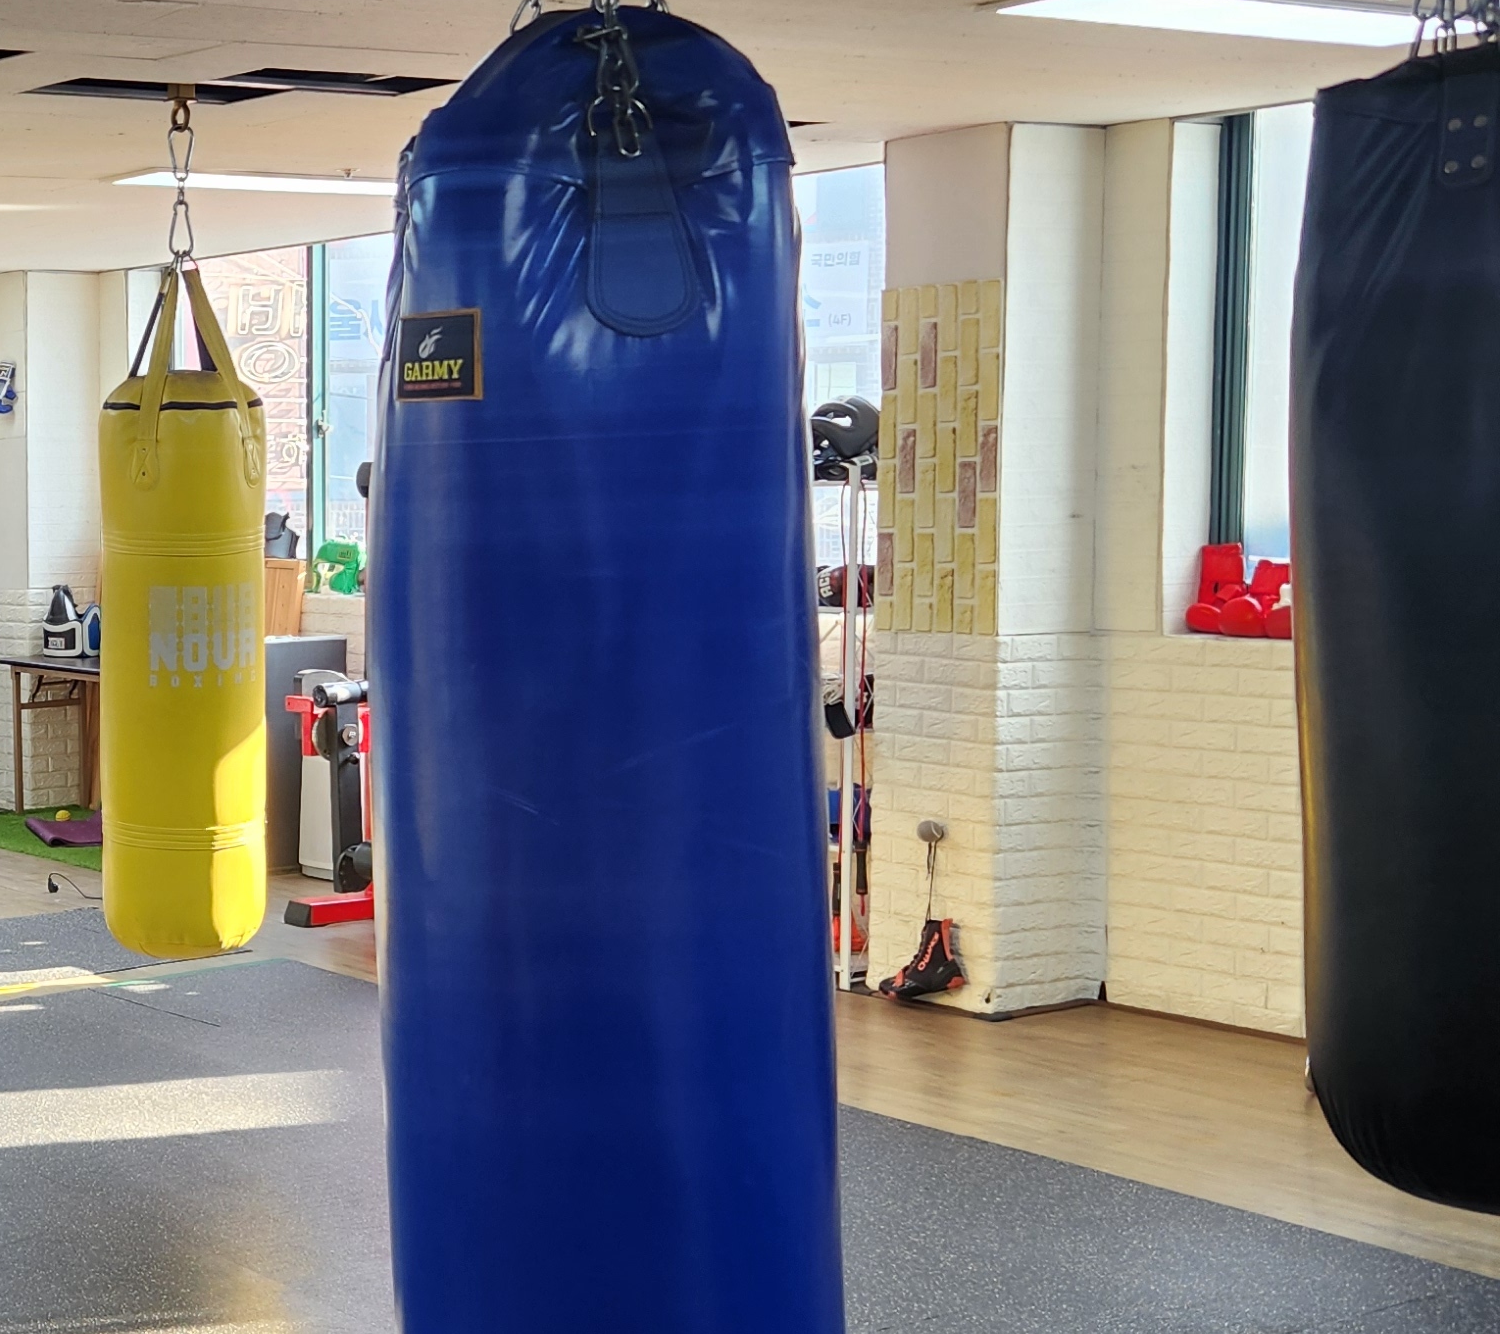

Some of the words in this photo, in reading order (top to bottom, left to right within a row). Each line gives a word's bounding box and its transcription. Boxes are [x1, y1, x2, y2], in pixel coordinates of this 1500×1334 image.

[810, 250, 862, 267] 국민의힘
[827, 312, 852, 328] (4F)
[403, 358, 464, 382] GARMY
